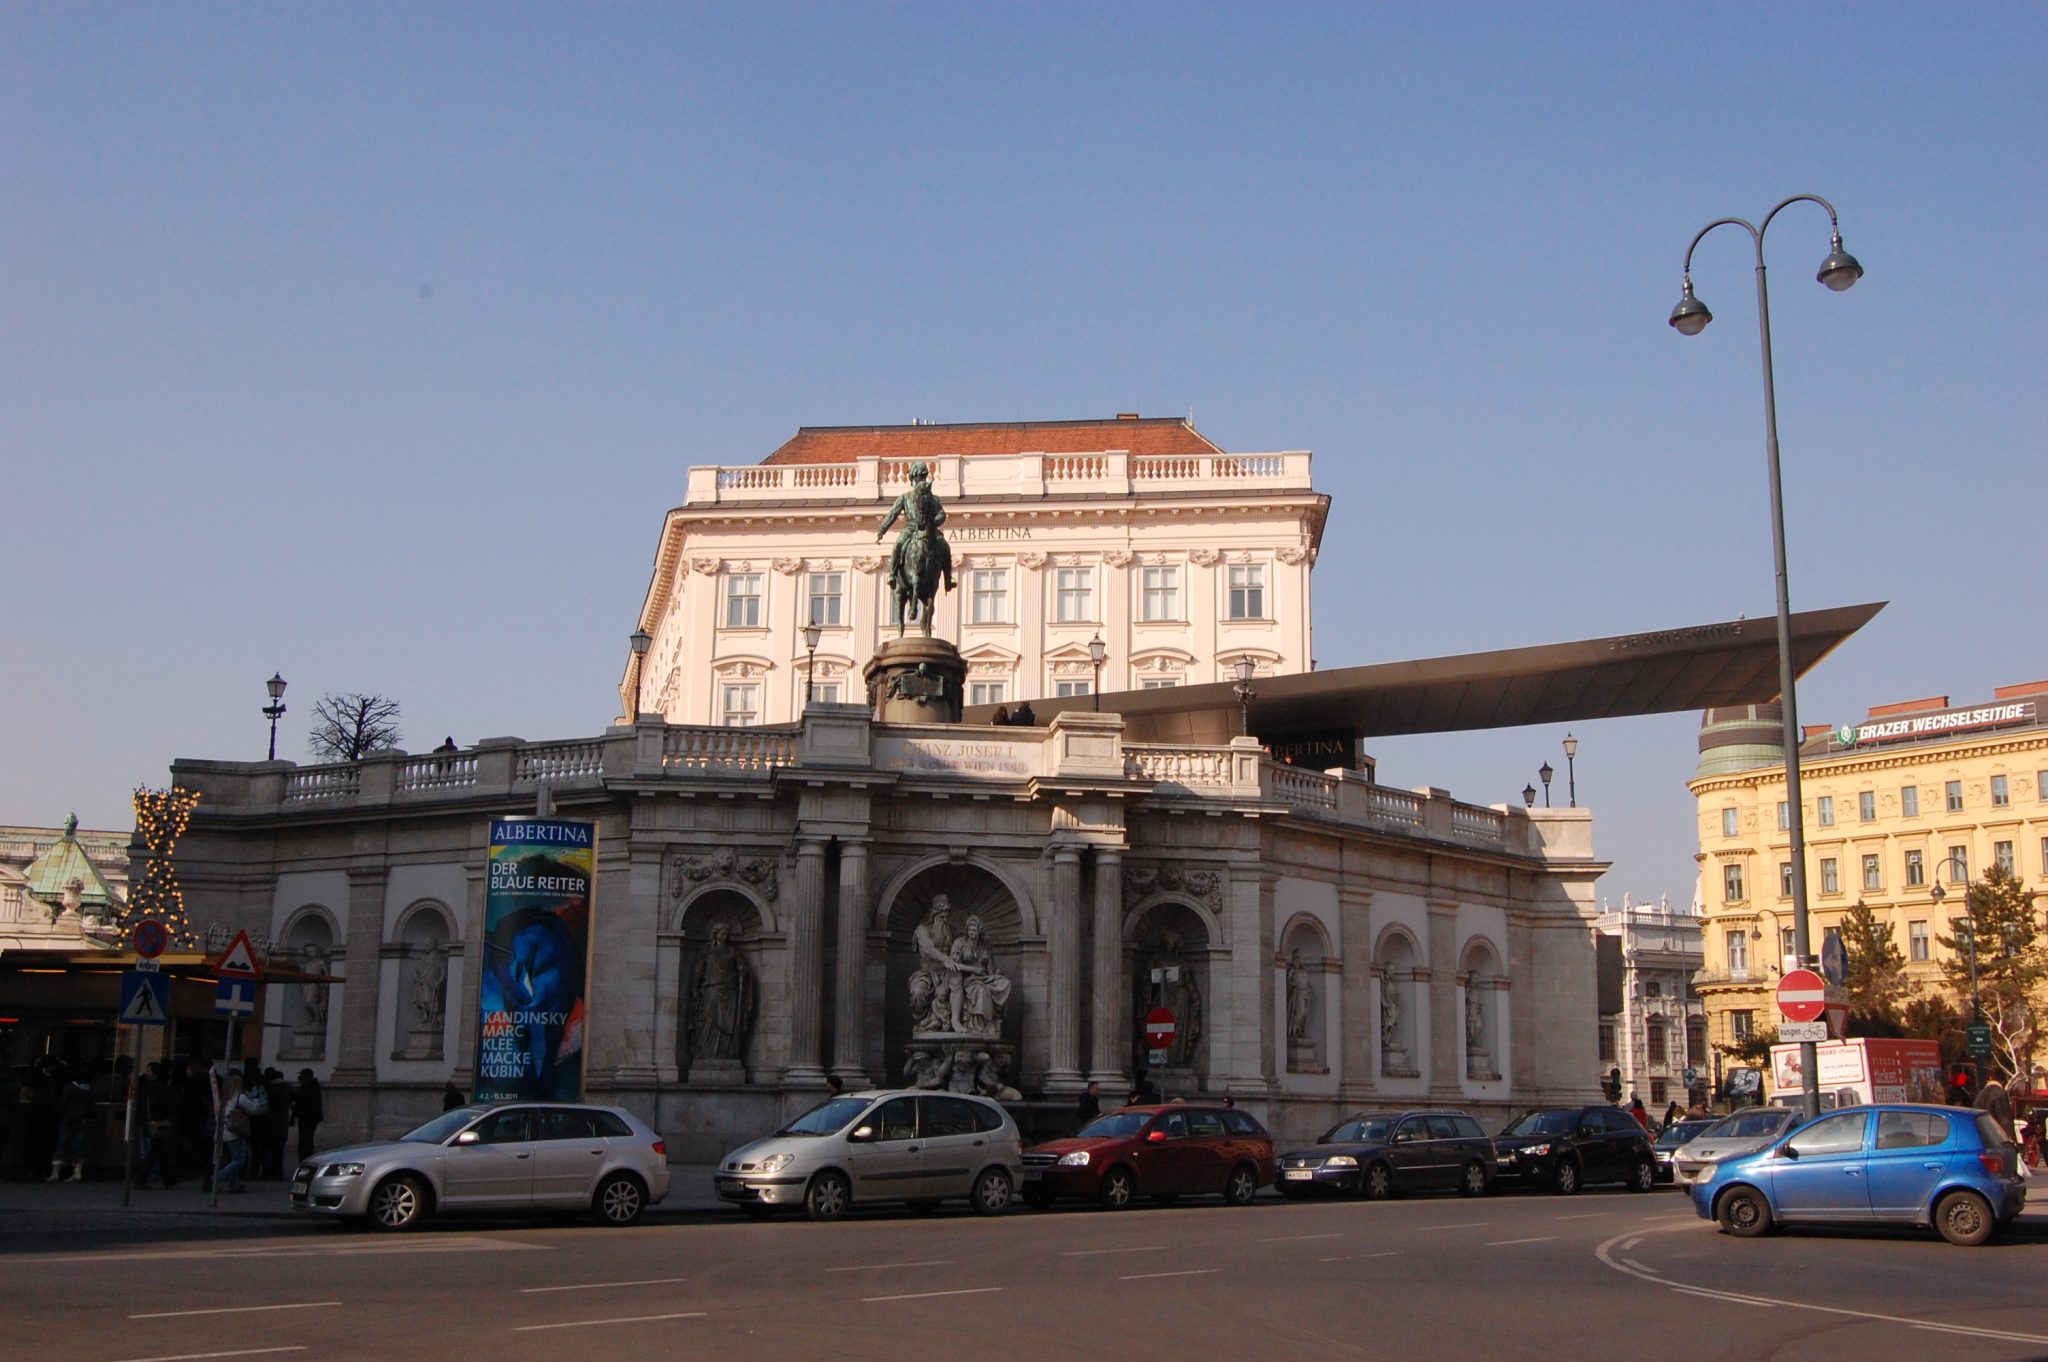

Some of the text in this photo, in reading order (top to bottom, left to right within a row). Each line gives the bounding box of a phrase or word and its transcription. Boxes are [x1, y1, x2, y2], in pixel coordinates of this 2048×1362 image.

[949, 527, 1031, 541] ALBERTINA
[1860, 703, 2024, 740] GRAZER WECHSELSEITIGE
[957, 744, 1003, 758] JOSEF
[495, 824, 588, 843] ALBERTINA
[492, 862, 517, 875] DER
[491, 876, 585, 891] BLAUE REITER
[484, 1011, 568, 1025] KANDINSKY
[482, 1025, 524, 1037] MARC
[482, 1038, 513, 1051] KLEE
[481, 1052, 530, 1065] MACKE
[481, 1065, 524, 1078] KUBIN
